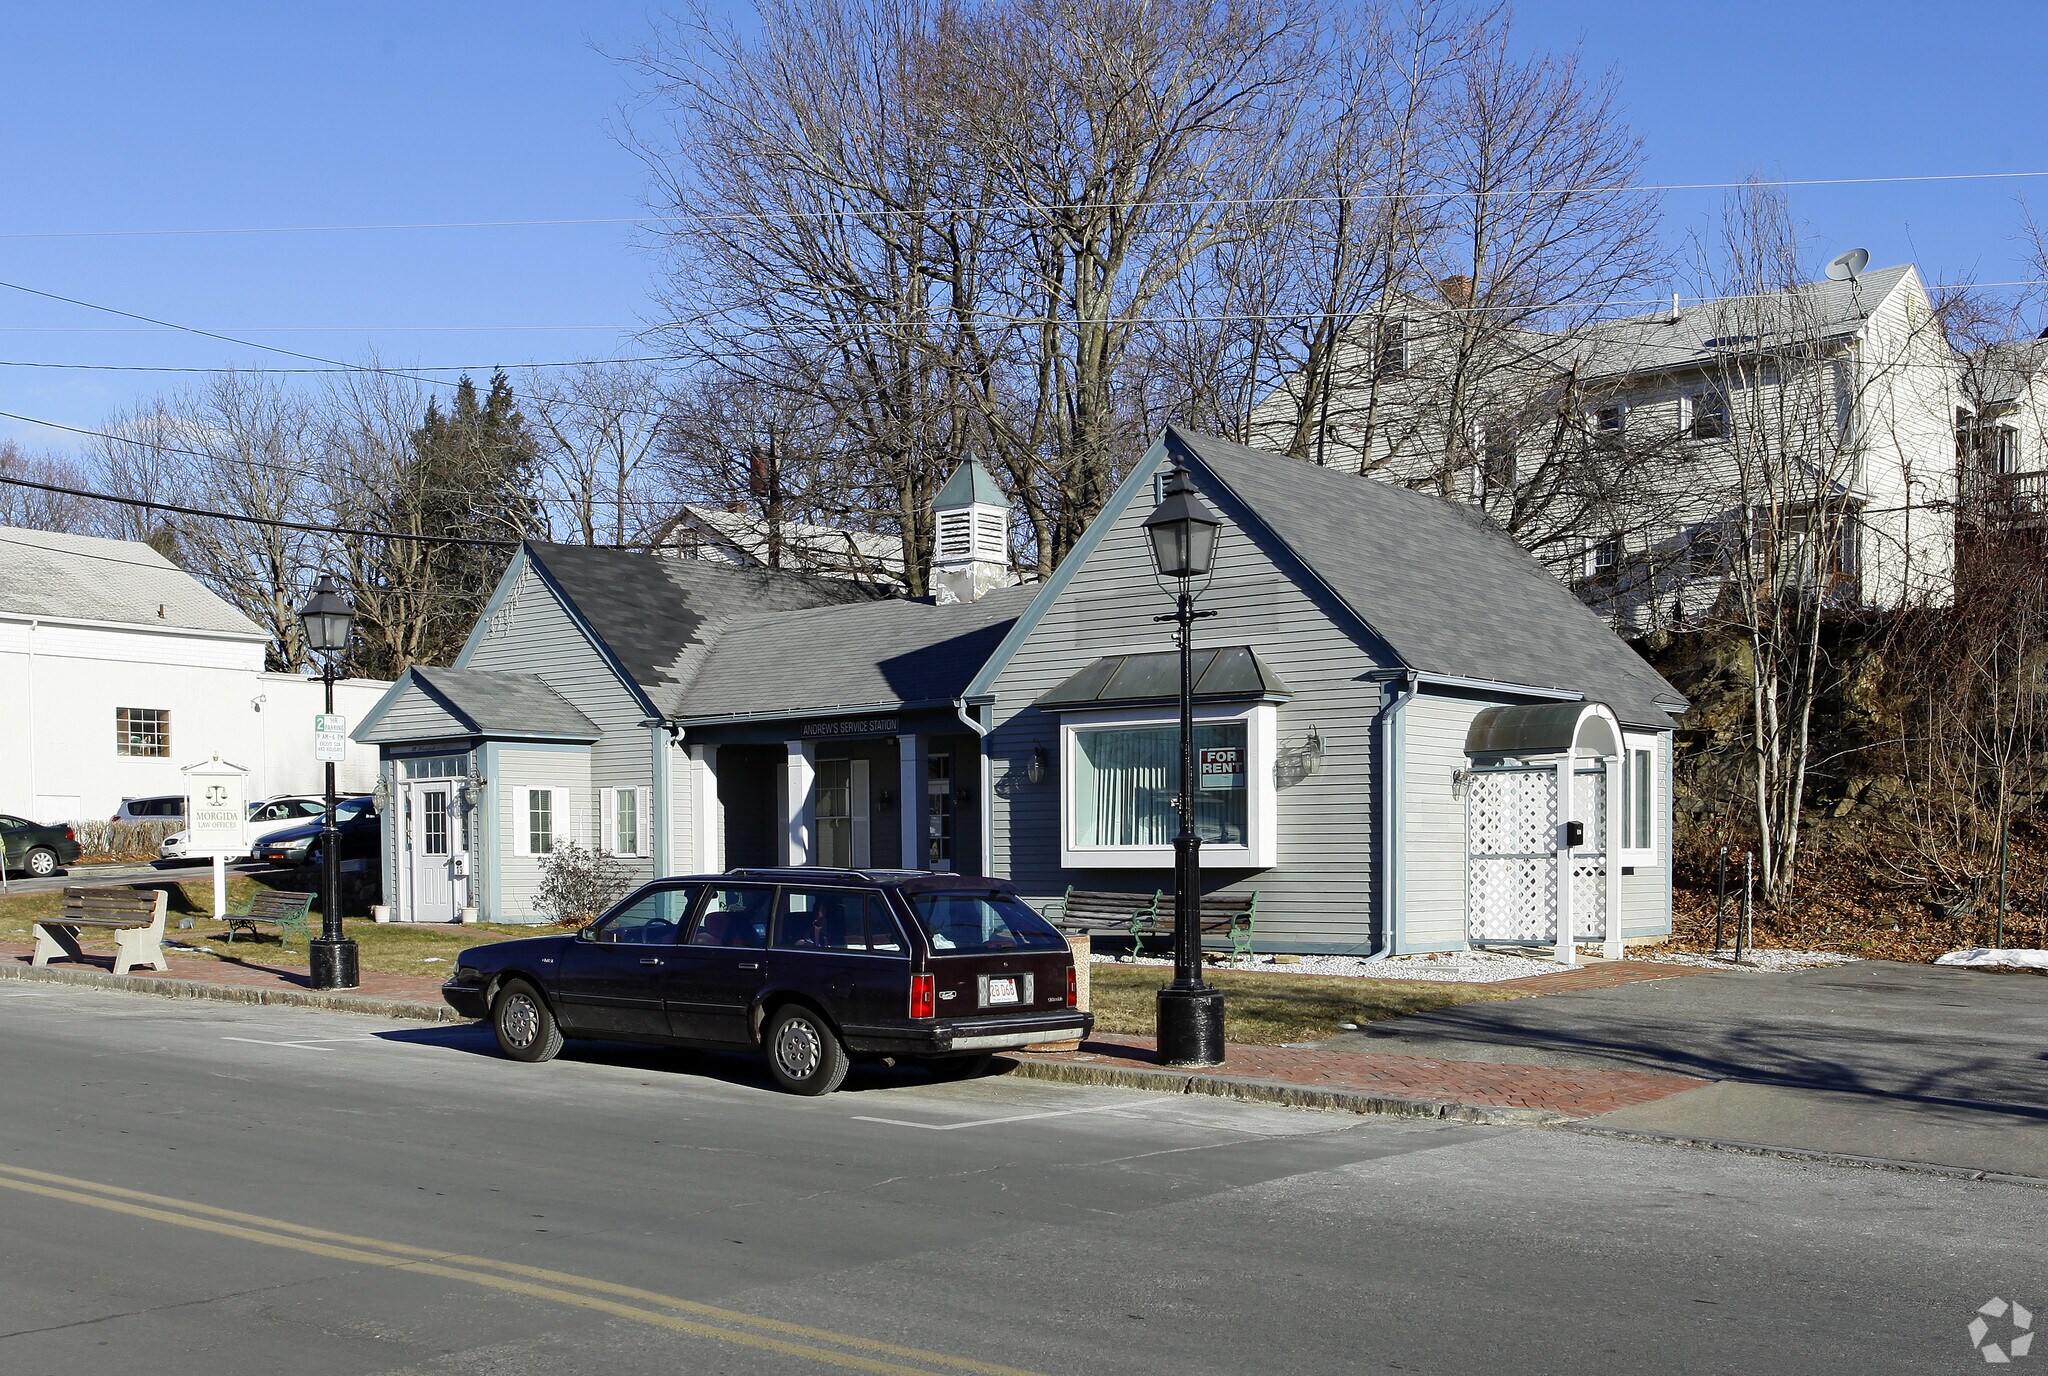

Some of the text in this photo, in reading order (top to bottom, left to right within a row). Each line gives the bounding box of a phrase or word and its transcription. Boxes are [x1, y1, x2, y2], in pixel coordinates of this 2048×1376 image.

[316, 718, 324, 730] 2
[802, 719, 896, 735] ANDREW'S SERVICE STATION
[1207, 752, 1236, 762] FOR
[1202, 762, 1242, 773] RENT
[196, 812, 238, 820] MORGIDA
